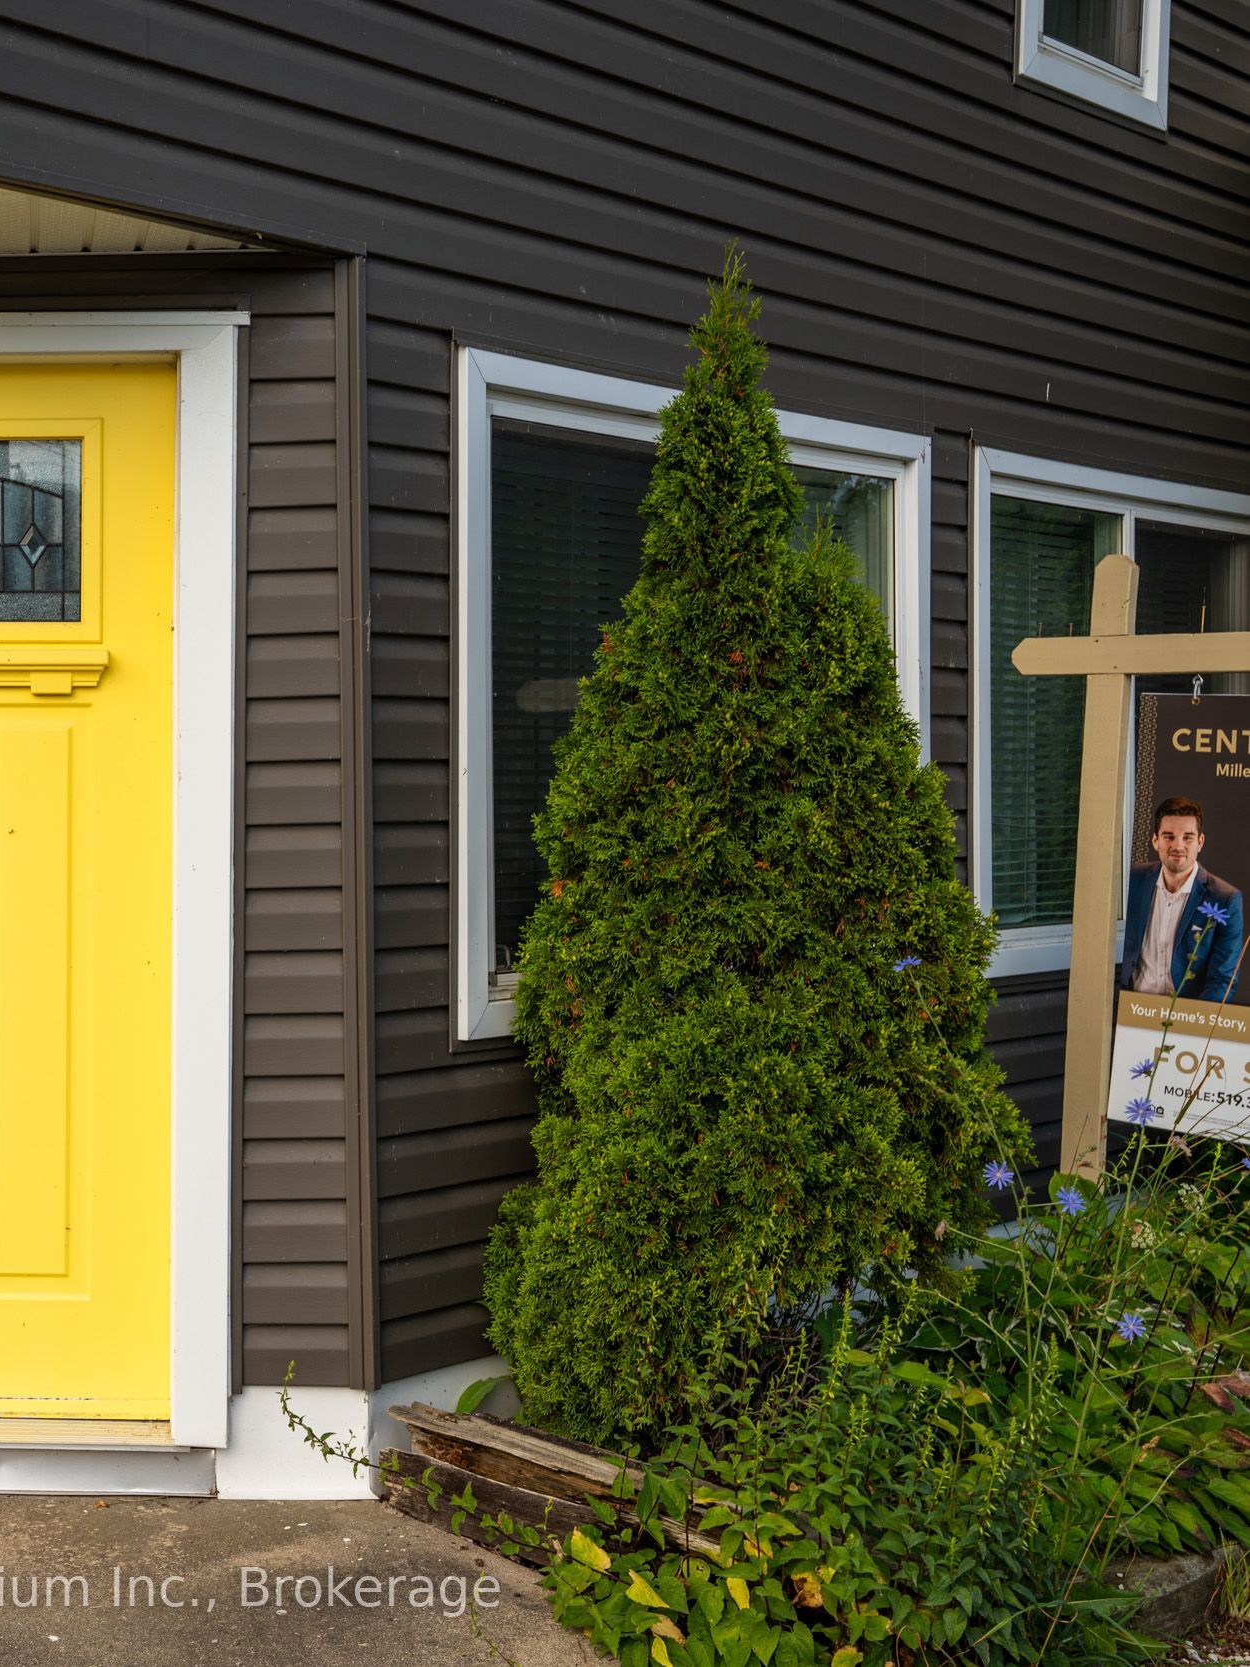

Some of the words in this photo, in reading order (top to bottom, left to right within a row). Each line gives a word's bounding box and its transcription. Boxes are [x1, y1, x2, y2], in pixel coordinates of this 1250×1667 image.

[1131, 1003, 1157, 1018] Your
[1160, 1007, 1205, 1024] Home's
[1209, 1014, 1246, 1033] Story,
[1153, 1046, 1225, 1079] FOR
